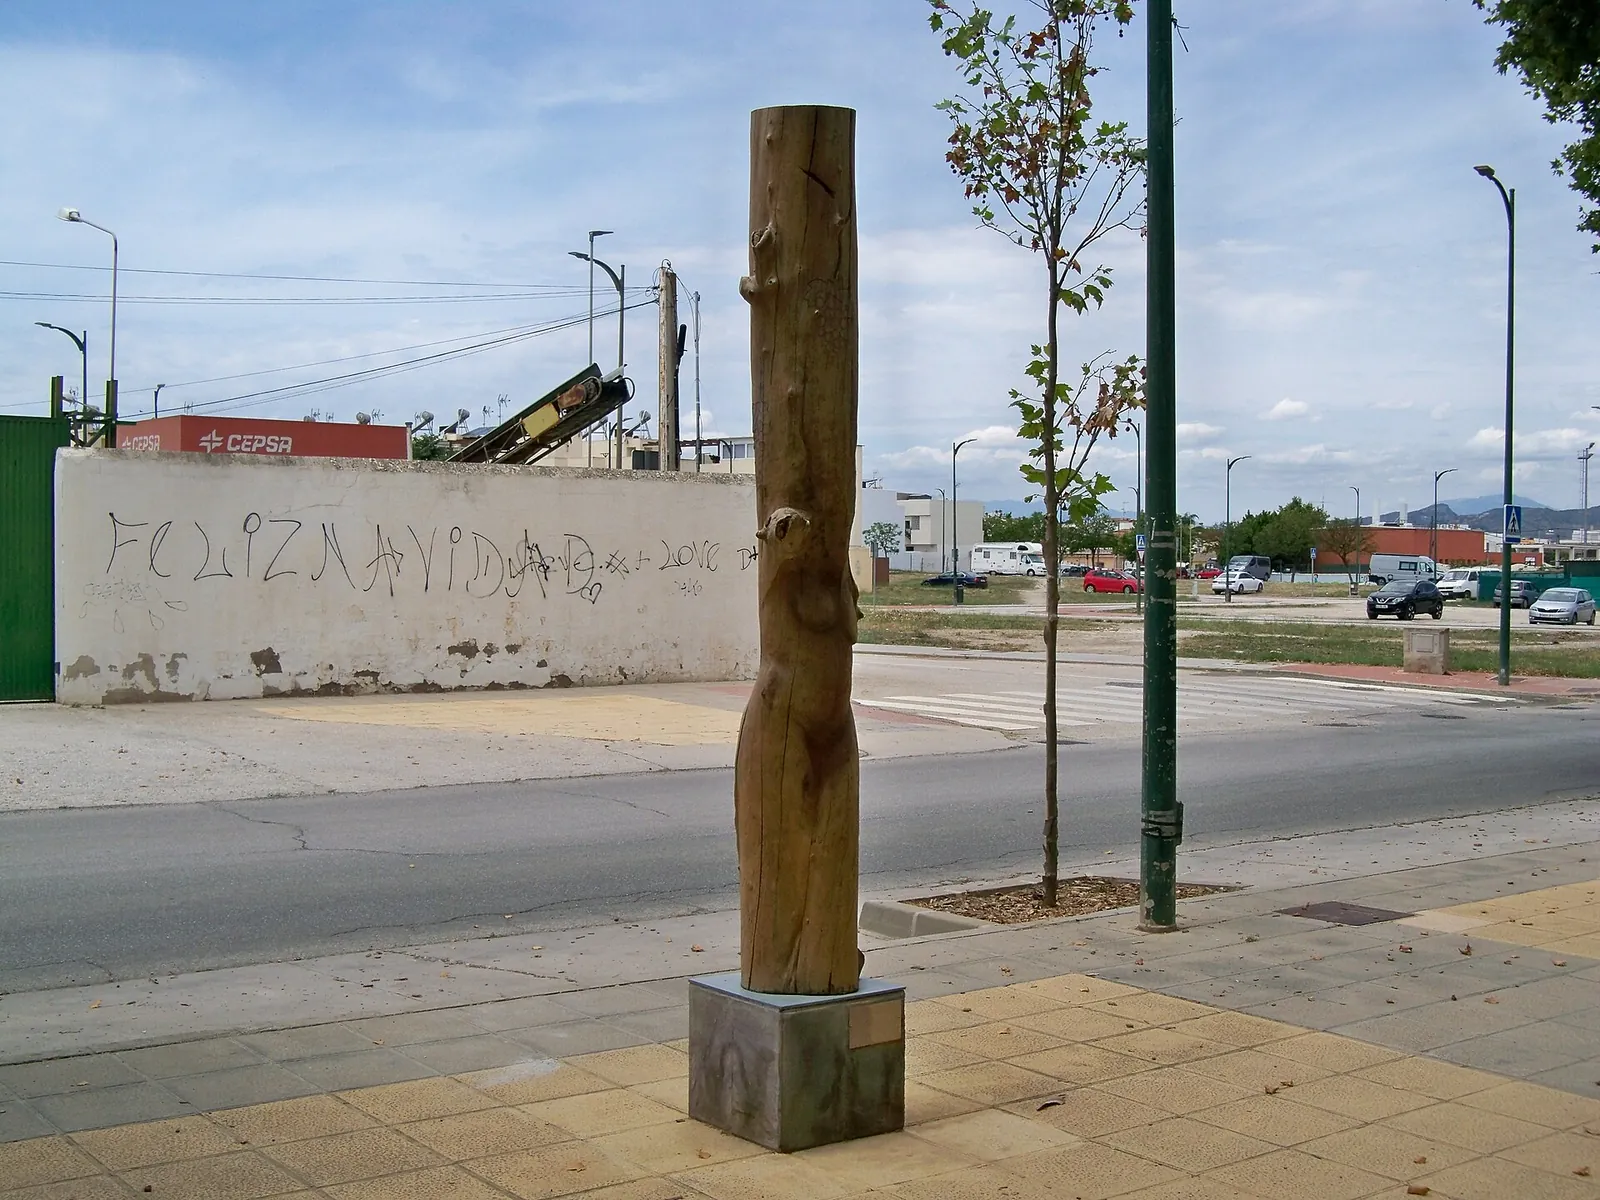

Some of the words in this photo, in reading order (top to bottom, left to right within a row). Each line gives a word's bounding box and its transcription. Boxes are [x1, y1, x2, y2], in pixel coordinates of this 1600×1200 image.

[132, 434, 161, 450] CEPSA
[227, 434, 293, 453] CEPSA
[658, 539, 720, 573] LOVE
